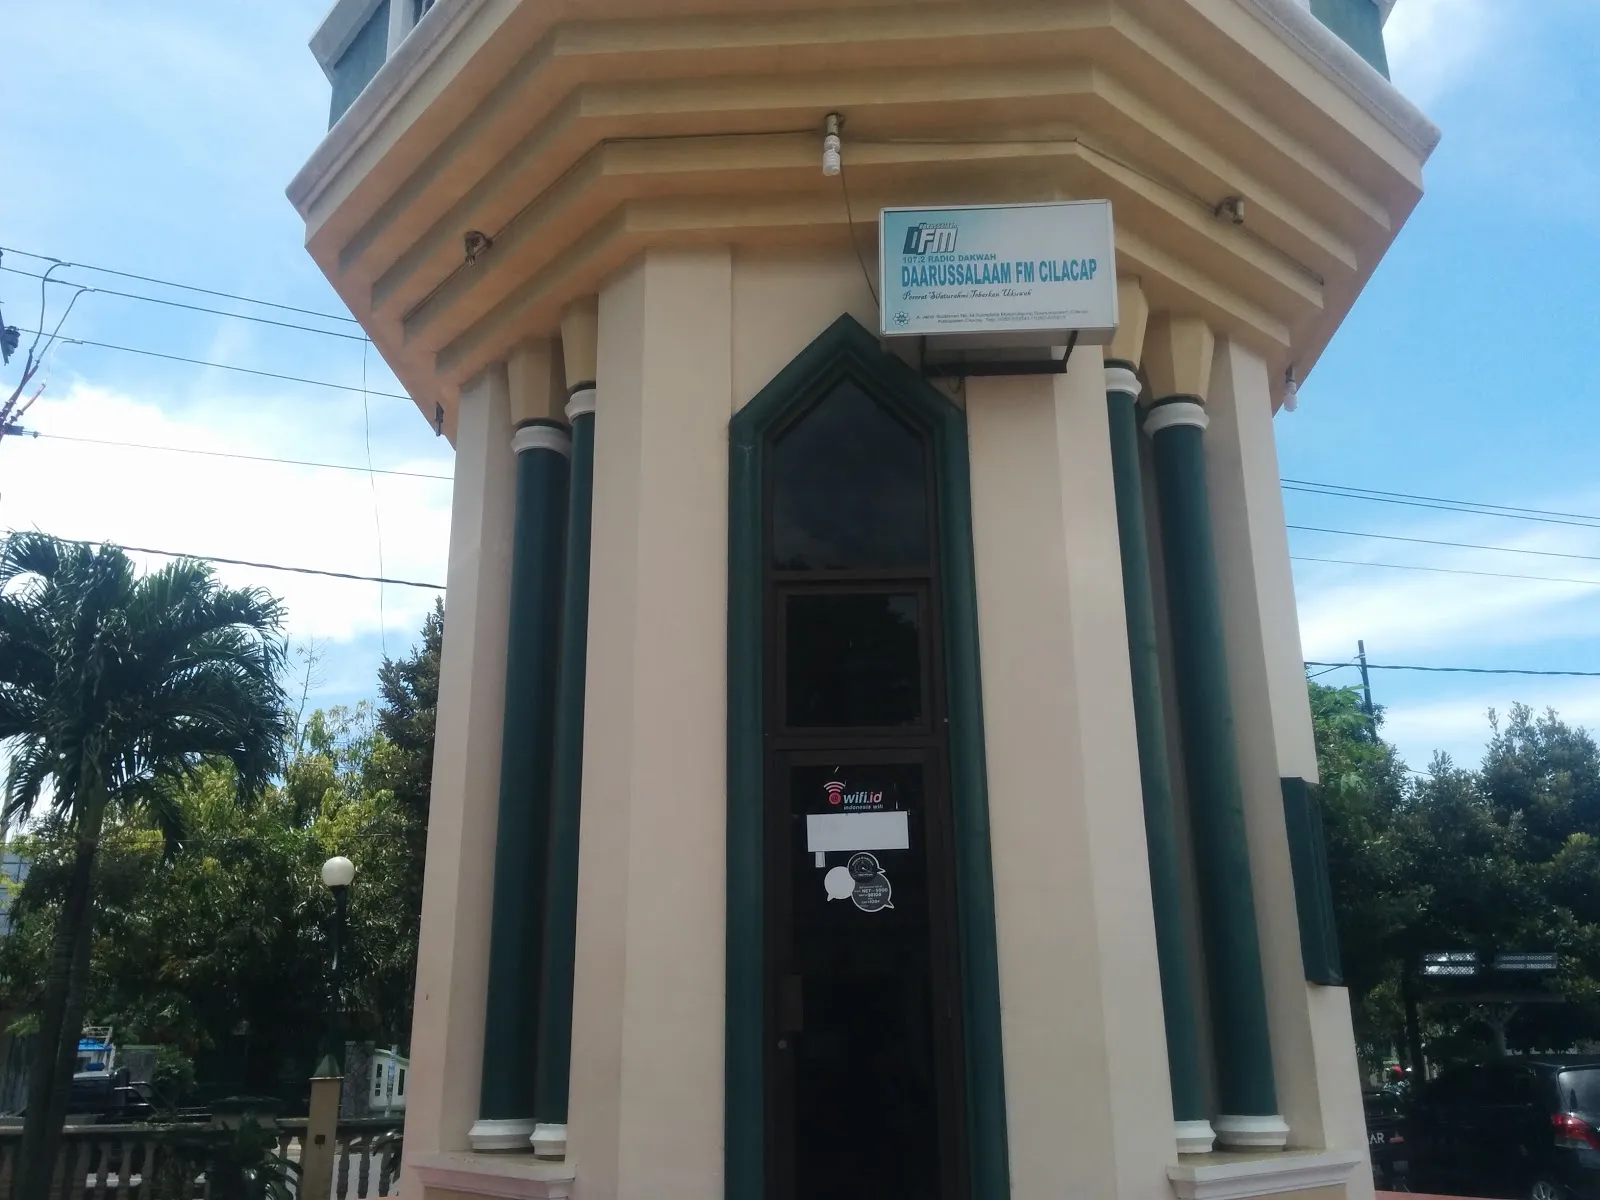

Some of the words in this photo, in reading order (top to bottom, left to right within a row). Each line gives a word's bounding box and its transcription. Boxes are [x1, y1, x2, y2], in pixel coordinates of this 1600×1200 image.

[903, 256, 926, 264] 107.2
[928, 255, 956, 263] RADIO
[958, 253, 997, 262] DAKWAH
[901, 262, 1011, 288] DAARUSSALAAM
[1015, 261, 1035, 283] FM
[1038, 258, 1097, 282] CILACAP
